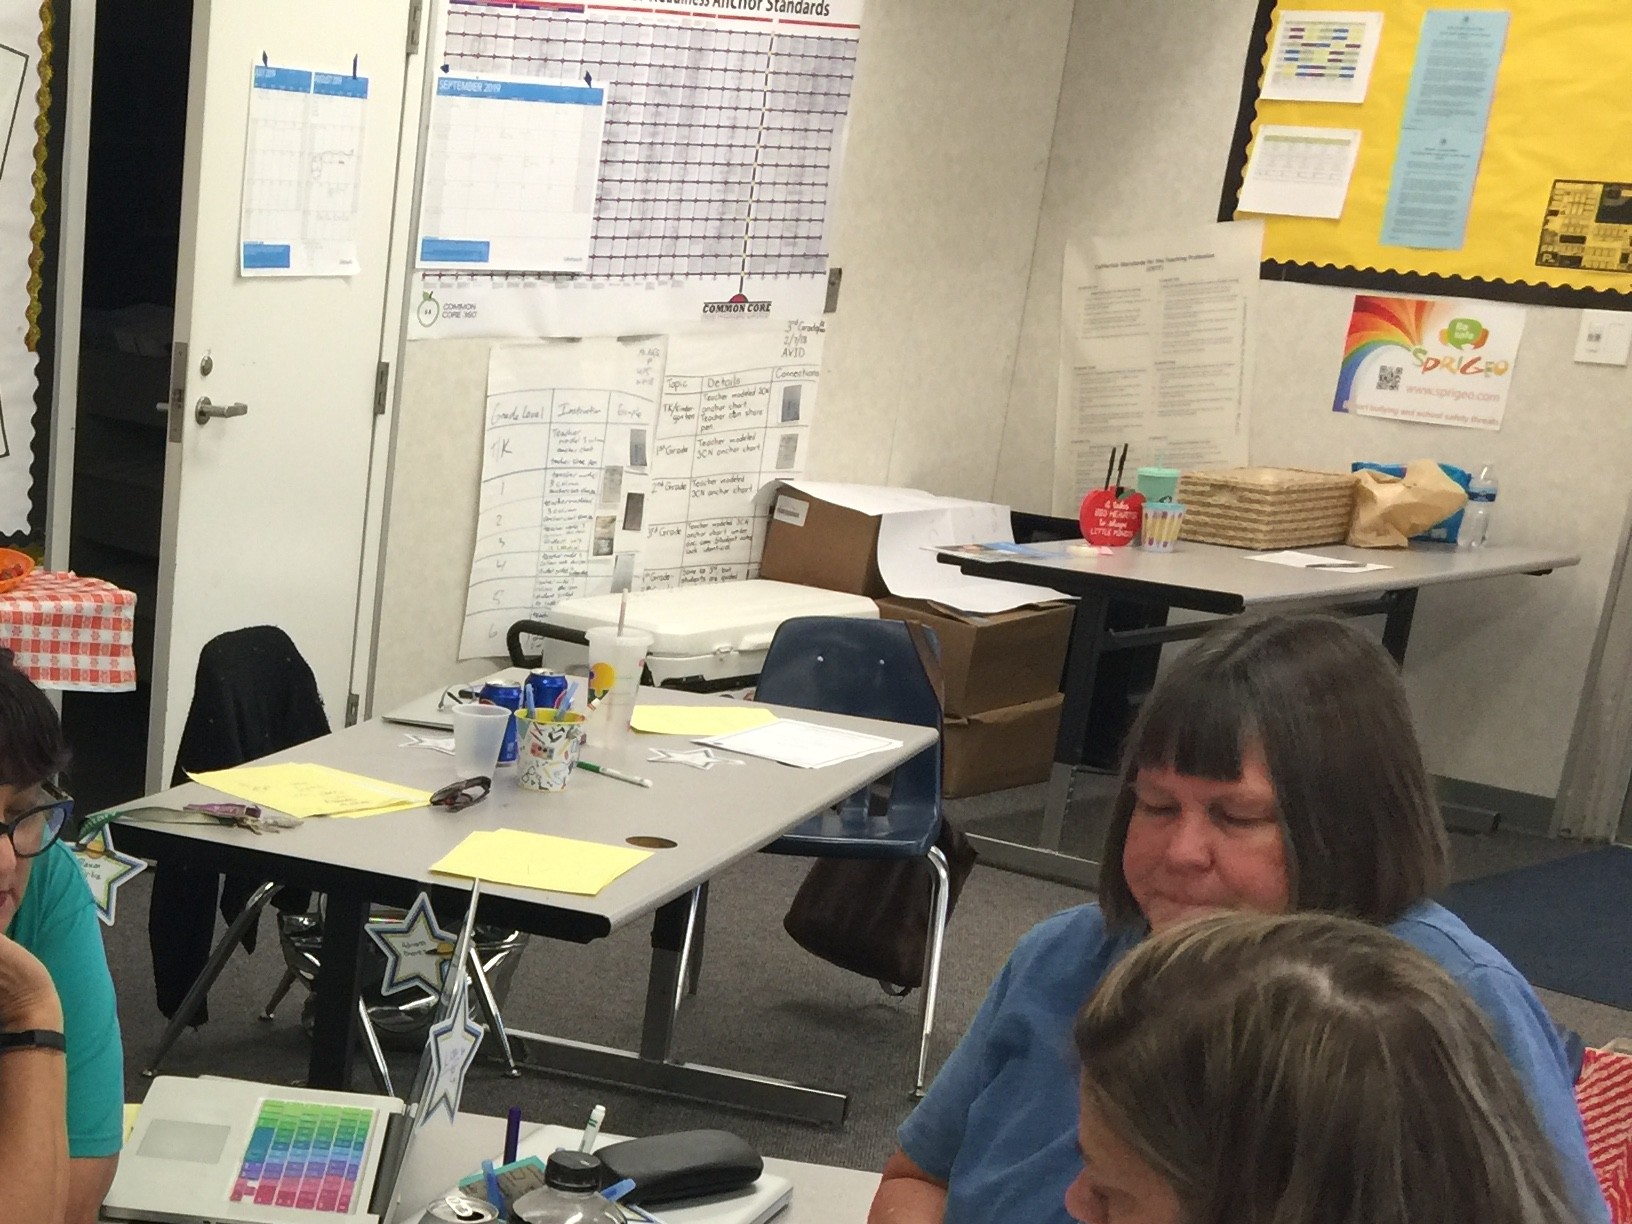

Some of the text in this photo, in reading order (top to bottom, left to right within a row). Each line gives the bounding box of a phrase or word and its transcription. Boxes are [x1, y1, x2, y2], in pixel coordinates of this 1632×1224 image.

[766, 0, 830, 17] Standards
[439, 79, 502, 93] SEPTEMBER 2019
[442, 303, 476, 311] COMMON
[703, 303, 772, 313] COMMON CORE
[781, 348, 805, 358] AVID
[1412, 345, 1509, 378] SPRIGEO
[707, 375, 740, 388] Details
[1406, 384, 1500, 402] www.sprigeo.com
